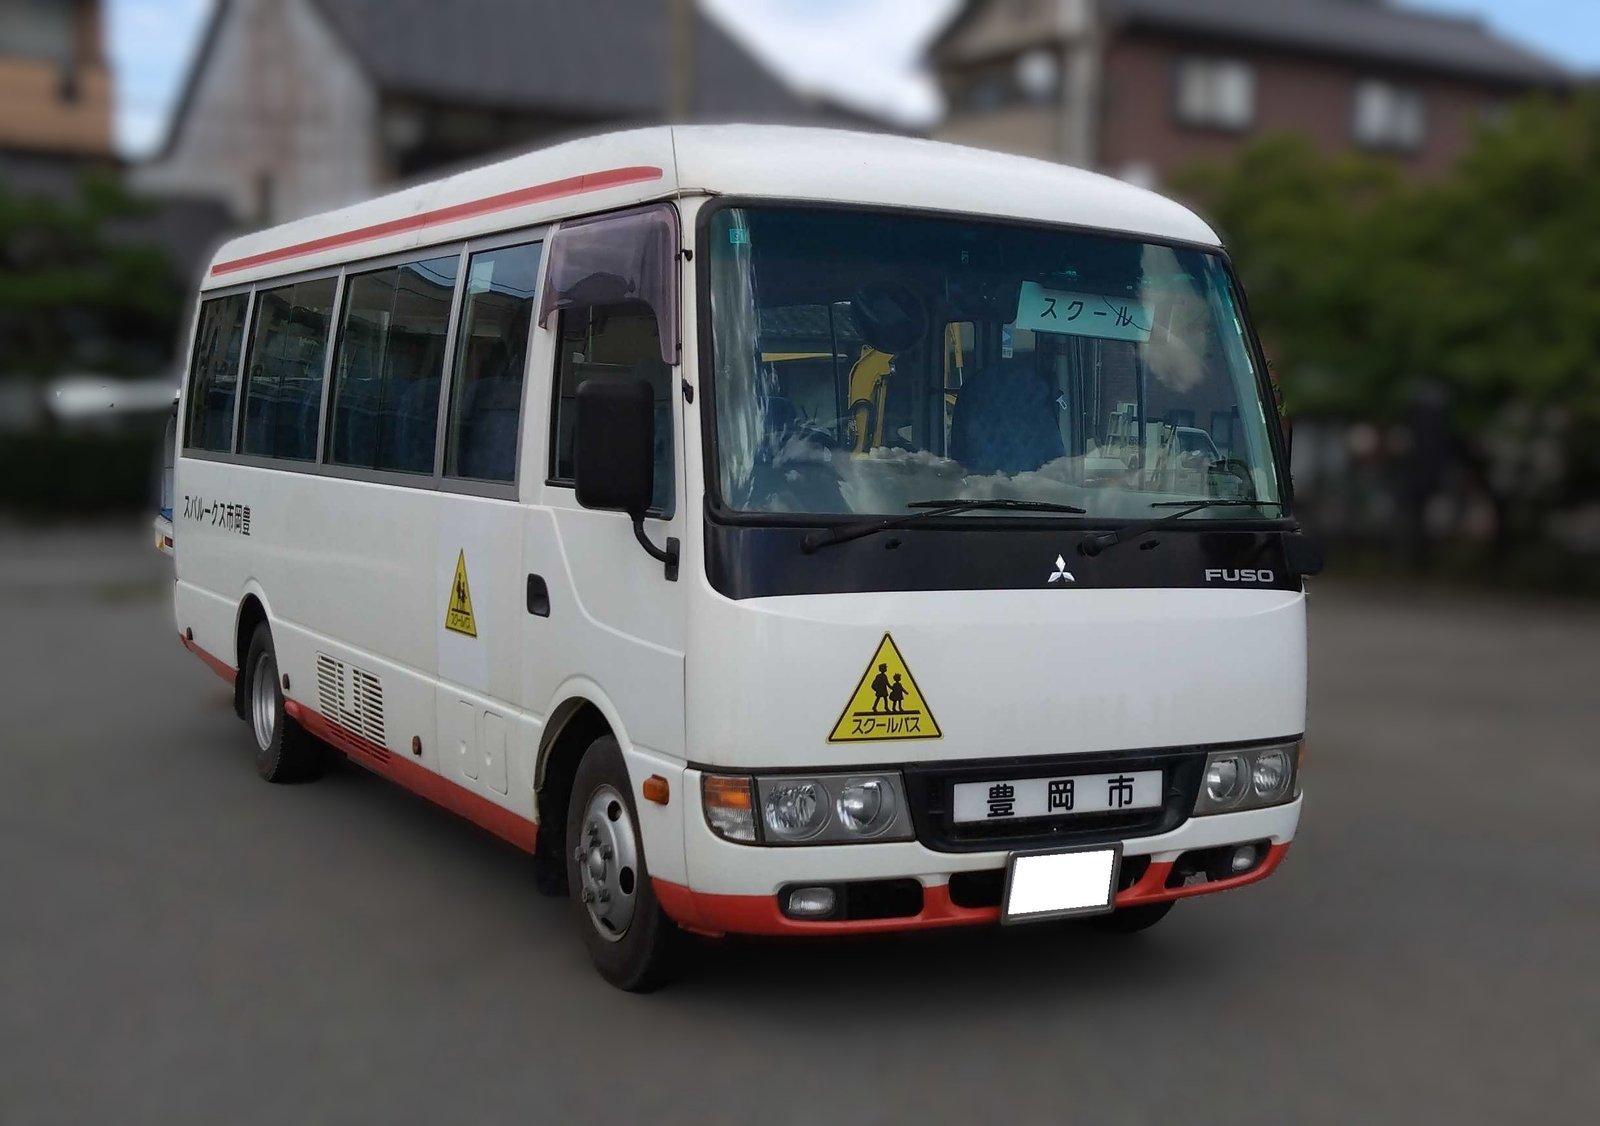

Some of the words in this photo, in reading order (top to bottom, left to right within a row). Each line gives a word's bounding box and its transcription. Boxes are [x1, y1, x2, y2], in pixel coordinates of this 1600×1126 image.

[1040, 297, 1133, 327] スクール
[1205, 569, 1274, 582] FUSO
[851, 716, 921, 735] スクールバス
[987, 774, 1135, 818] 豊岡市
